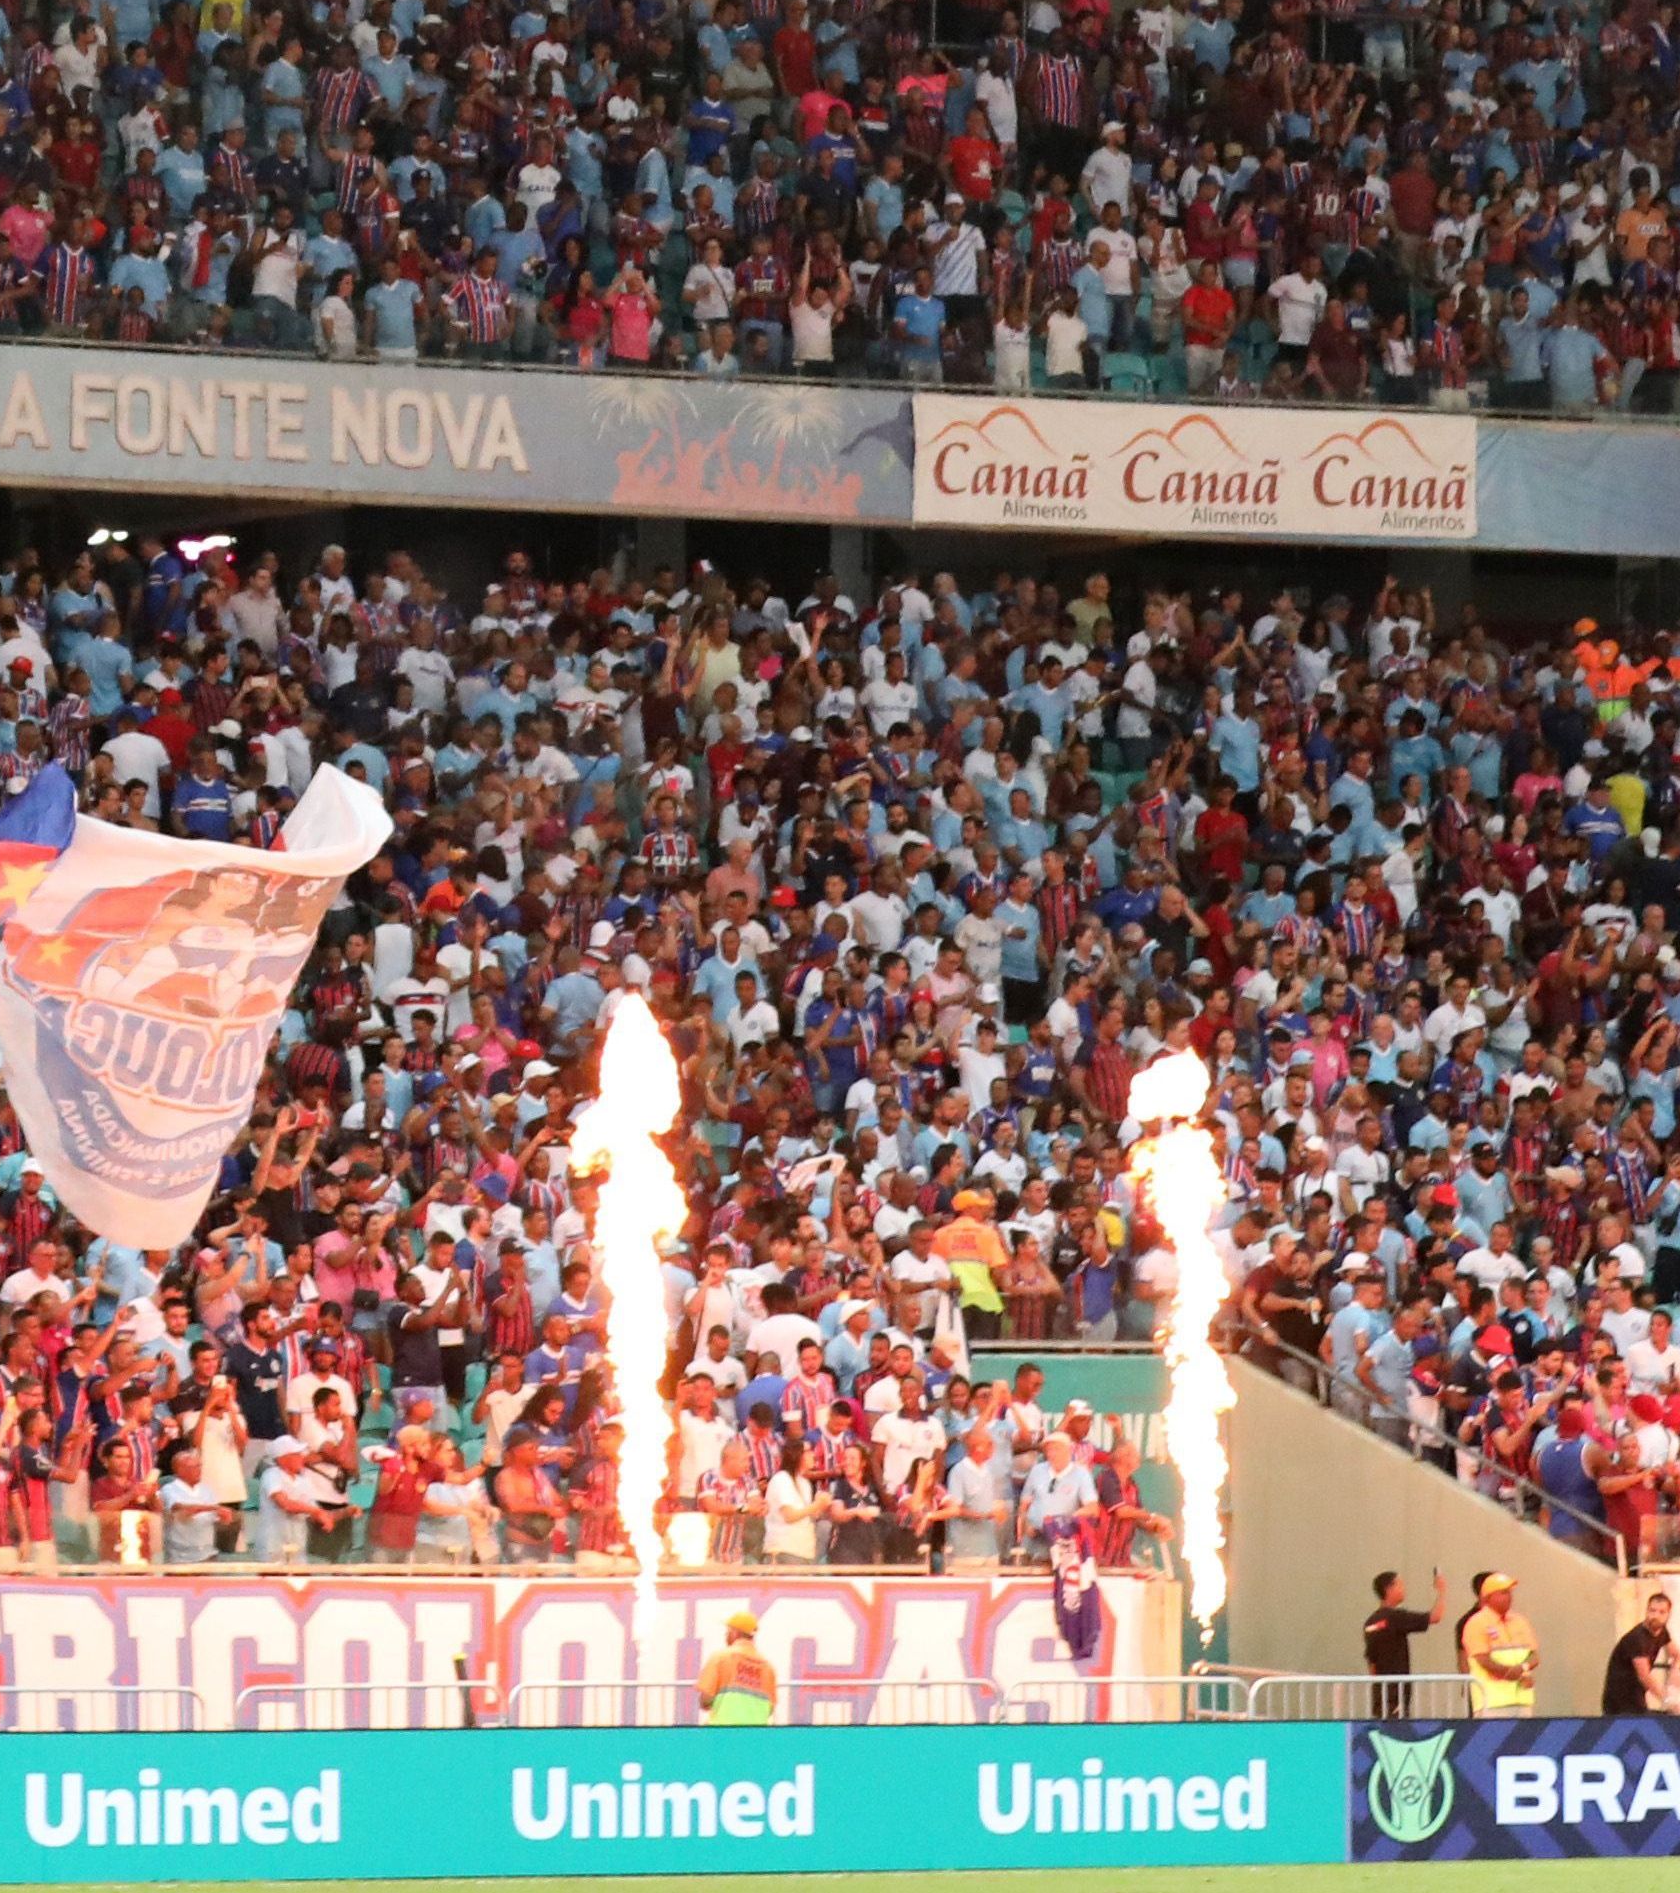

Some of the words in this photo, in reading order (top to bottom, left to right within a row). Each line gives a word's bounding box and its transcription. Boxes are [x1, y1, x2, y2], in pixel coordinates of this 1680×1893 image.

[1313, 192, 1341, 217] 10
[69, 371, 309, 465] FONTE
[328, 385, 530, 474] NOVA
[932, 441, 1090, 501] Canaã
[1121, 448, 1281, 508] Canaã
[1312, 453, 1468, 511] Canaã
[1001, 498, 1088, 522] Alimentos
[1190, 505, 1279, 528] Alimentos
[1379, 509, 1467, 532] Alimentos
[25, 1767, 342, 1847] Unimed
[512, 1762, 816, 1842] Unimed
[977, 1758, 1268, 1836] Unimed
